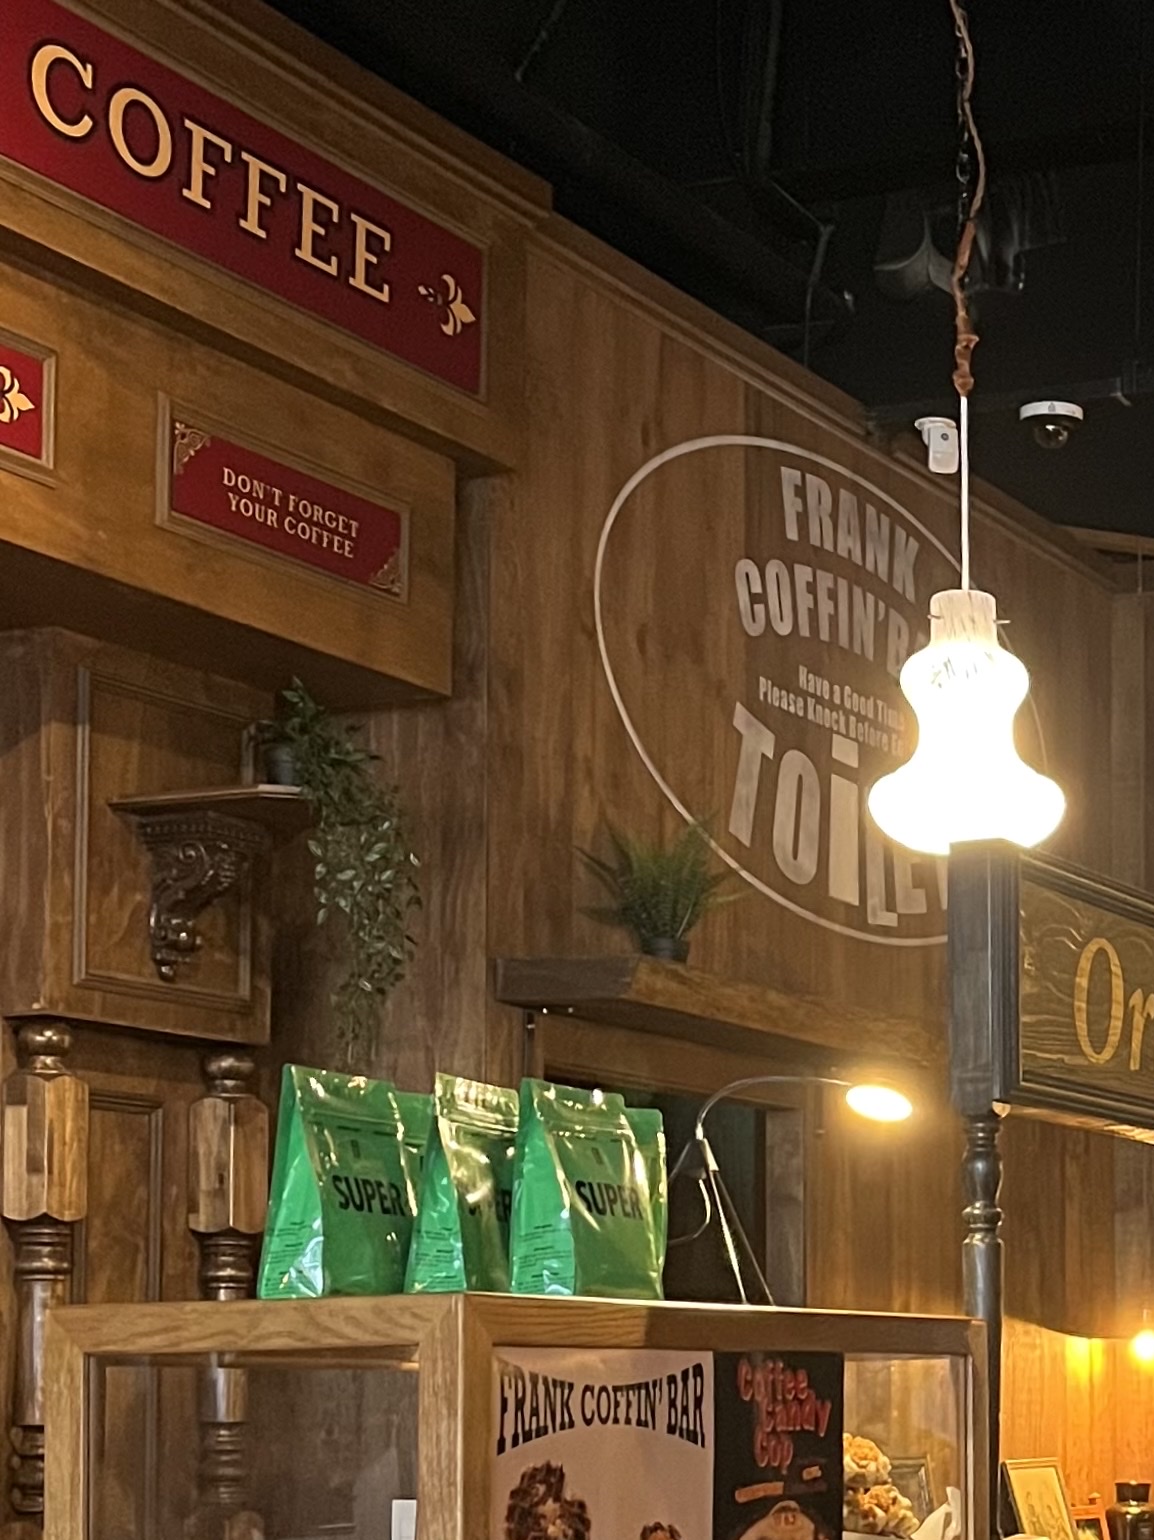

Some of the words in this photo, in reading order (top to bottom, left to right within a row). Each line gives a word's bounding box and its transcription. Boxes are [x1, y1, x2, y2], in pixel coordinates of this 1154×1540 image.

[31, 44, 391, 303] COFFEE
[222, 466, 283, 506] DON'T
[288, 495, 359, 538] FORGET
[227, 491, 279, 529] YOUR
[283, 514, 354, 558] COFFEE
[780, 466, 920, 602] FRANK
[759, 676, 805, 717] Please
[807, 697, 847, 735] Knock
[799, 664, 830, 700] Have
[832, 684, 841, 705] a
[843, 685, 874, 720] Good
[331, 1174, 406, 1217] SUPER
[575, 1179, 643, 1220] SUPER
[497, 1362, 576, 1456] FRANK
[580, 1379, 665, 1432] COFFIN'
[666, 1362, 706, 1449] BAR
[737, 1358, 809, 1401] Coffee
